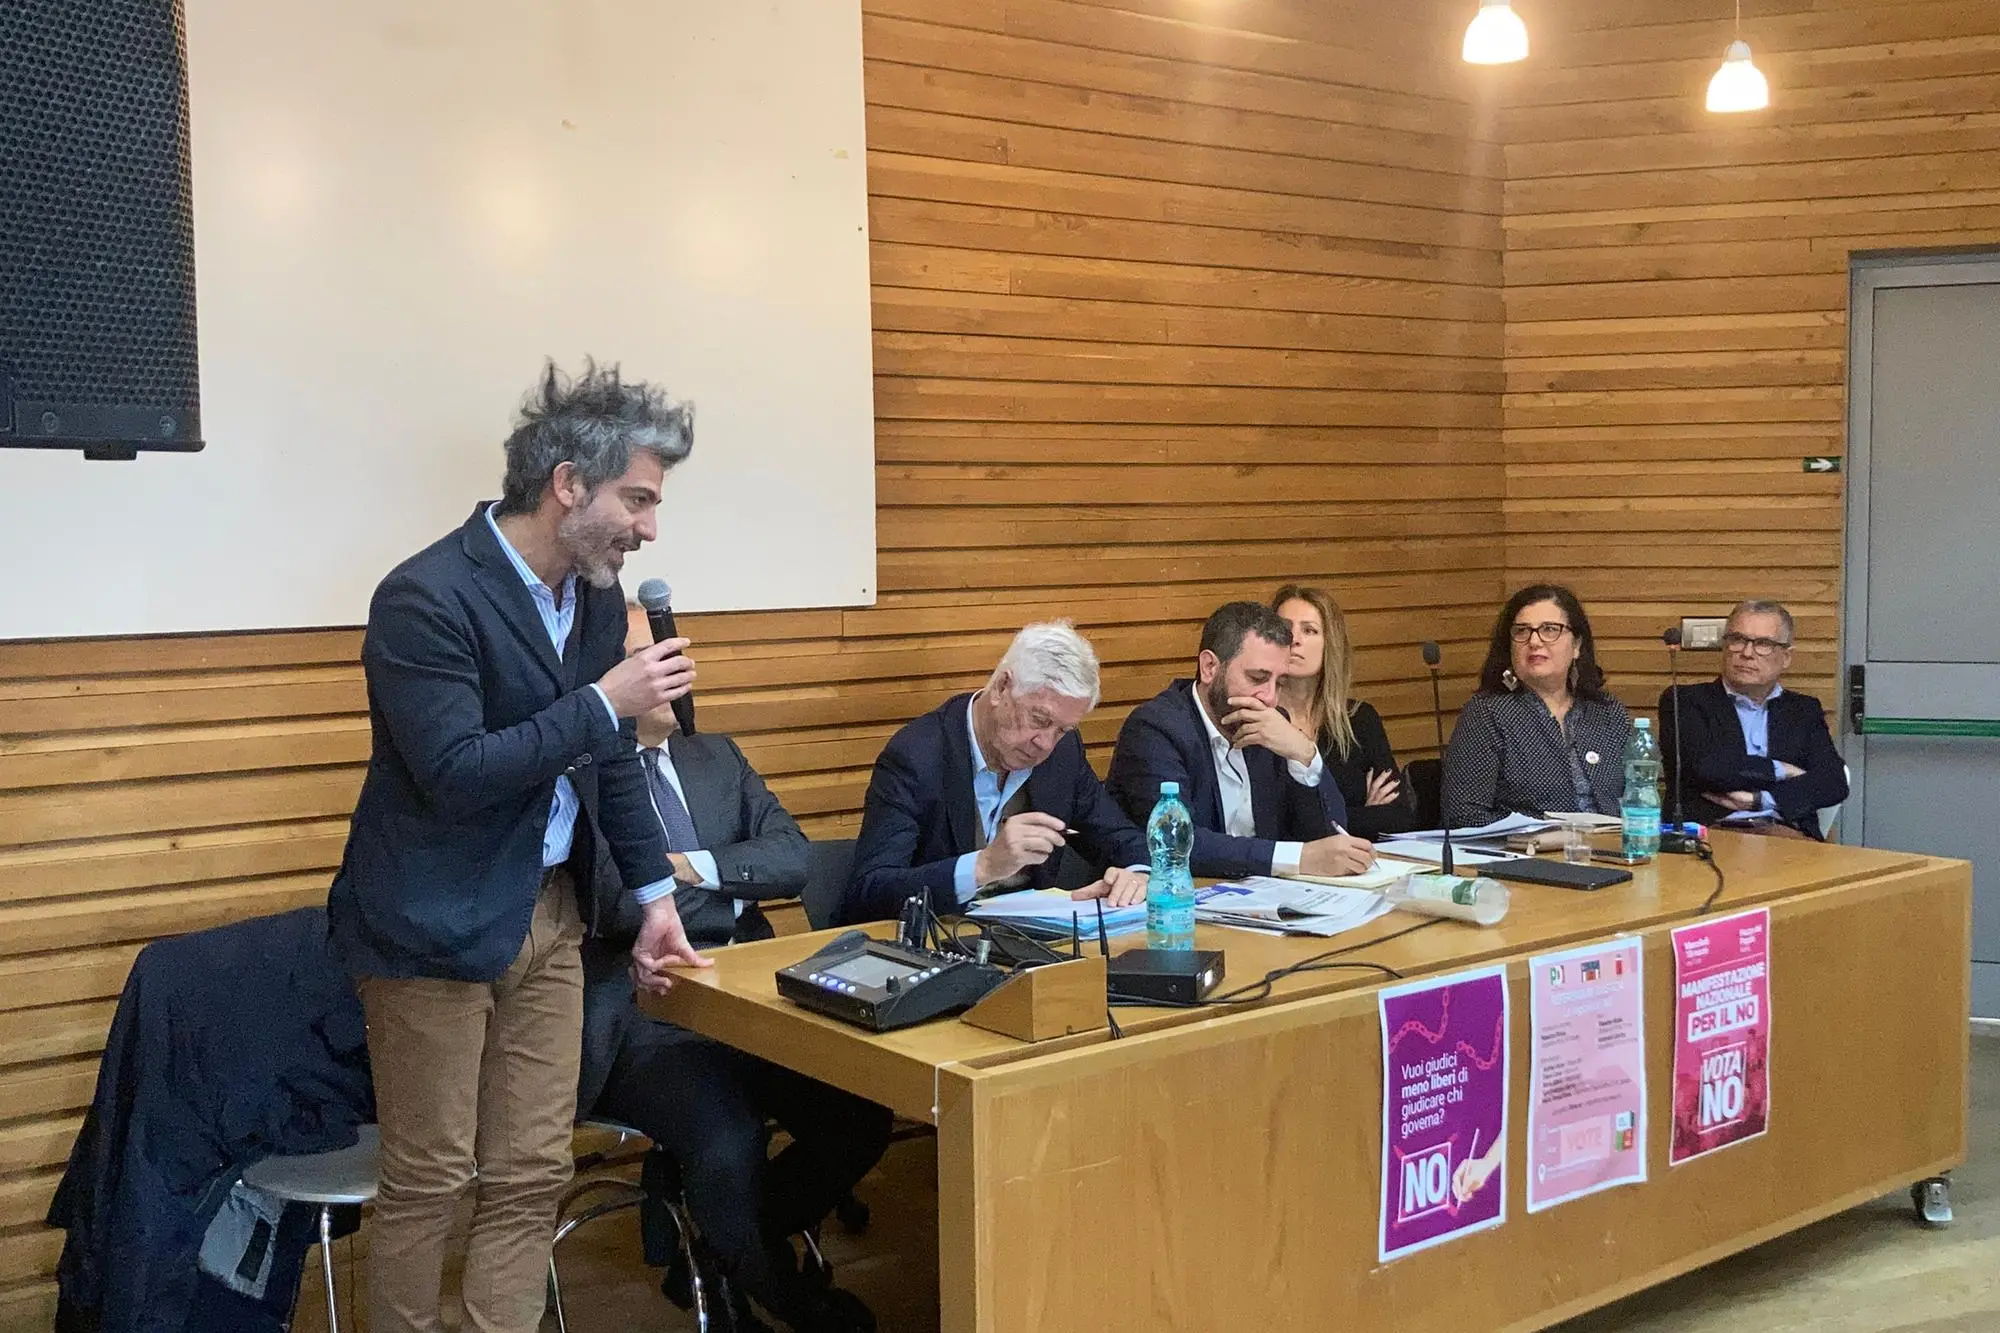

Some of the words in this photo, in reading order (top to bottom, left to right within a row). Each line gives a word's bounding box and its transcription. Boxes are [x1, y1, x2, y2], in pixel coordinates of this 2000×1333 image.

[1692, 1011, 1717, 1036] PER
[1720, 1007, 1732, 1027] IL
[1736, 1001, 1755, 1023] NO
[1401, 1059, 1424, 1080] Vuoi
[1425, 1051, 1457, 1077] giudici
[1401, 1080, 1430, 1099] meno
[1431, 1069, 1456, 1090] liberi
[1458, 1066, 1468, 1083] di
[1703, 1049, 1742, 1083] VOTA
[1401, 1093, 1445, 1121] giudicare
[1447, 1085, 1463, 1104] chi
[1702, 1075, 1743, 1127] NO
[1401, 1108, 1446, 1139] governa?
[1404, 1151, 1447, 1214] NO
